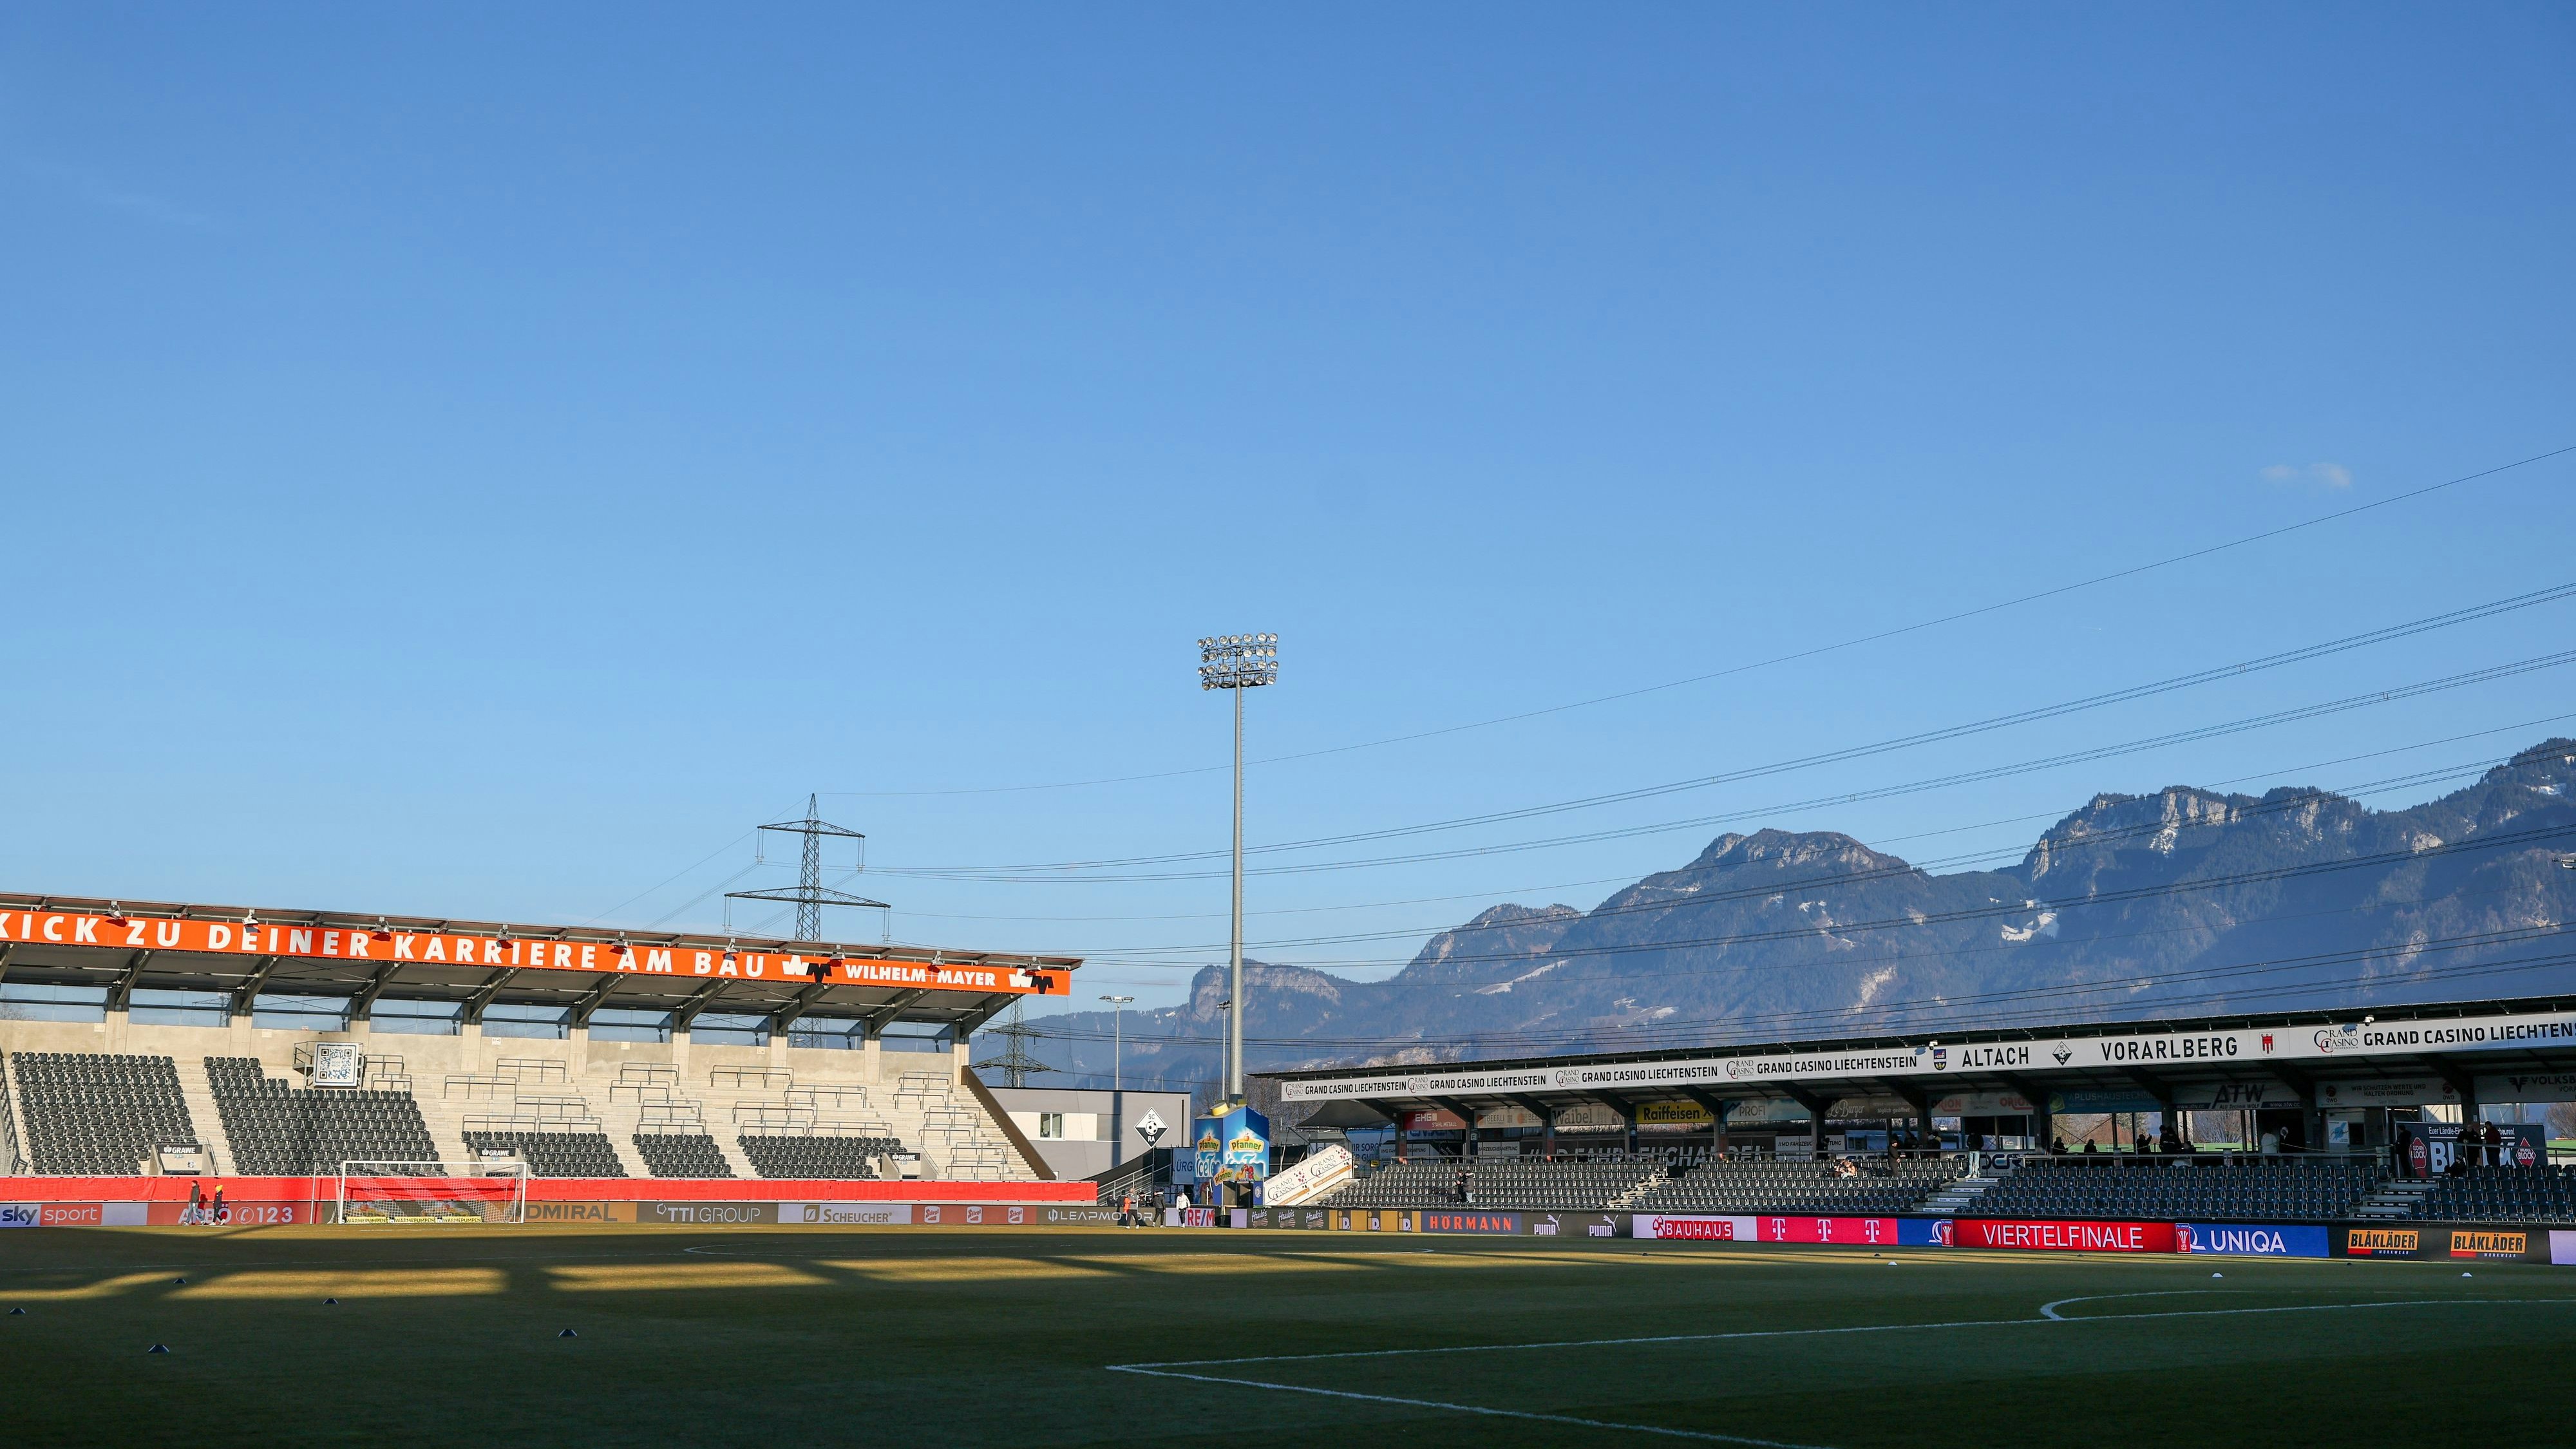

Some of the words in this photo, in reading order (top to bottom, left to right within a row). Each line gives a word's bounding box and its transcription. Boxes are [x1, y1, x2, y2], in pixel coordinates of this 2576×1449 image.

[126, 920, 181, 947] ZU
[208, 924, 368, 957] DEINER
[394, 934, 596, 969] KARRIERE
[617, 947, 672, 972] AM
[694, 952, 764, 977] BAU
[845, 964, 926, 983] WILHELM
[937, 971, 996, 986] MAYER
[2364, 1031, 2419, 1046] GRAND
[2424, 1027, 2485, 1044] CASINO
[2490, 1022, 2576, 1040] LIECHTEN
[1962, 1046, 2029, 1067] ALTACH
[2101, 1037, 2237, 1061] VORARLBERG
[1757, 1062, 1792, 1074] GRAND
[1795, 1060, 1832, 1072] CASINO
[1835, 1056, 1917, 1070] LIECHTENSTEIN
[1430, 1079, 1455, 1090] GRAND
[1457, 1078, 1484, 1088] CASINO
[1486, 1075, 1546, 1086] LIECHTENSTEIN
[1582, 1072, 1611, 1083] GRAND
[1614, 1070, 1645, 1081] CASINO
[1648, 1066, 1718, 1079] LIECHTENSTEIN
[1305, 1085, 1328, 1095] GRAND
[1329, 1084, 1353, 1094] CASINO
[1354, 1081, 1406, 1093] LIECHTENSTEIN
[1415, 1113, 1432, 1122] EHG
[1553, 1109, 1593, 1124] Waibel
[1643, 1106, 1700, 1121] Raiffeisen
[1739, 1106, 1765, 1117] PROFI
[2517, 1151, 2534, 1159] BLOCK
[3, 1206, 37, 1225] sky
[44, 1207, 97, 1224] sport
[668, 1207, 694, 1222] TTI
[699, 1207, 761, 1223] GROUP
[1430, 1215, 1511, 1231] HÖRMANN
[1534, 1224, 1556, 1235] PUMA
[1589, 1225, 1613, 1237] PUMA
[1665, 1221, 1732, 1237] BAUHAUS
[1982, 1224, 2144, 1249] VIERTELFINALE
[2210, 1230, 2286, 1253] UNIQA
